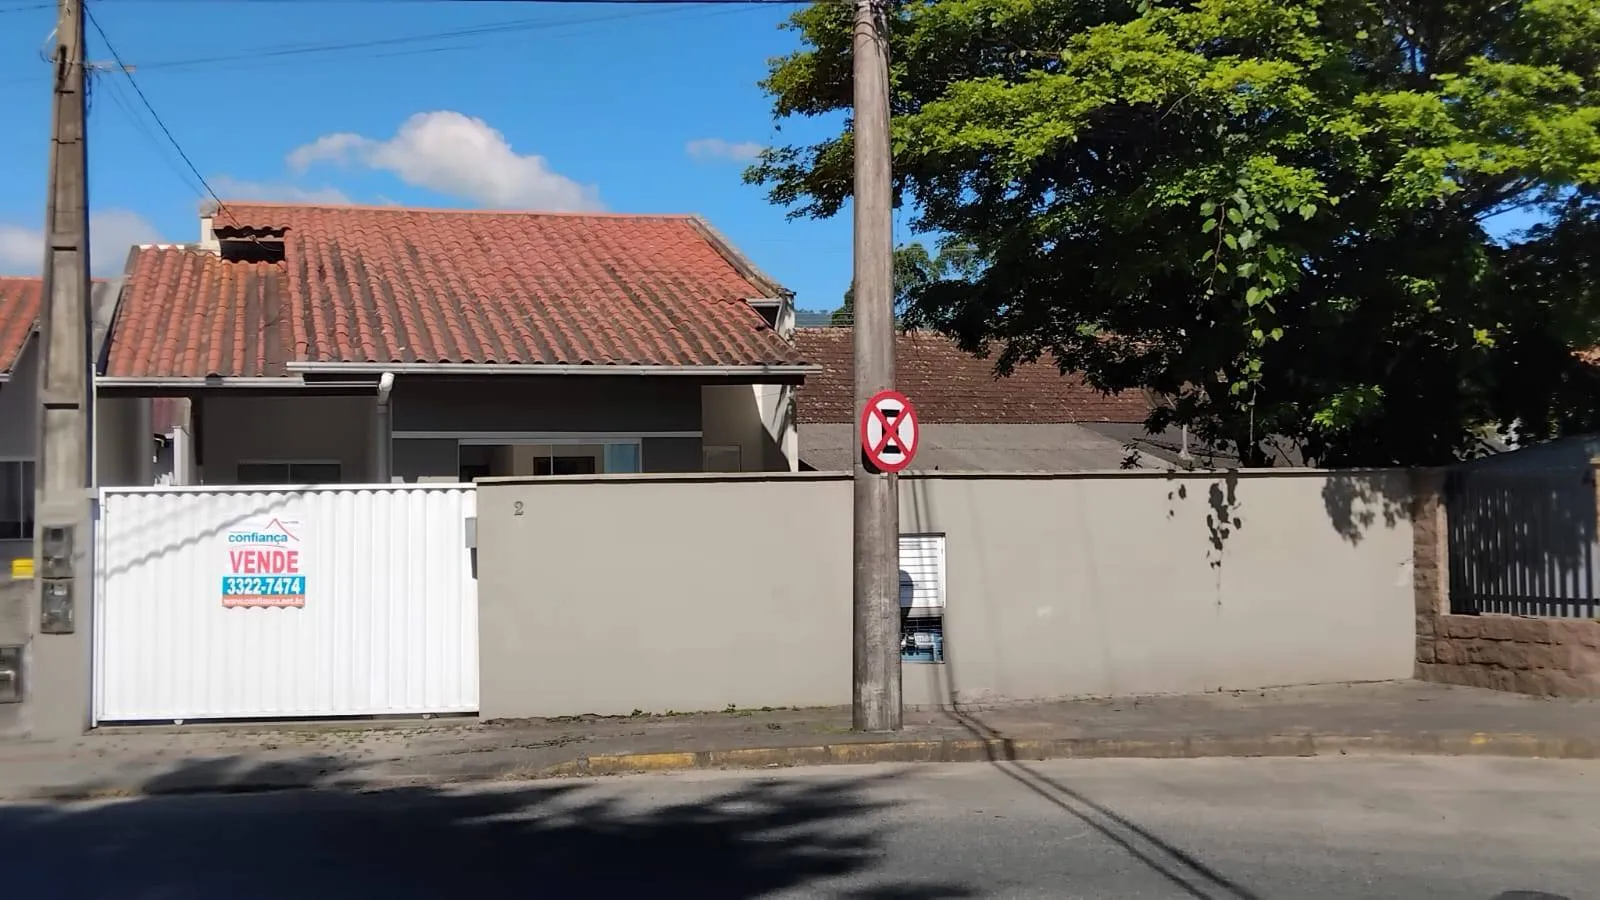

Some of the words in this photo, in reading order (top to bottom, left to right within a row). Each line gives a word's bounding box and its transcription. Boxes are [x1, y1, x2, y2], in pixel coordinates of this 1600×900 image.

[513, 501, 524, 516] 2
[228, 532, 288, 545] confiança
[229, 551, 299, 574] VENDE
[227, 577, 301, 595] 3322-7474
